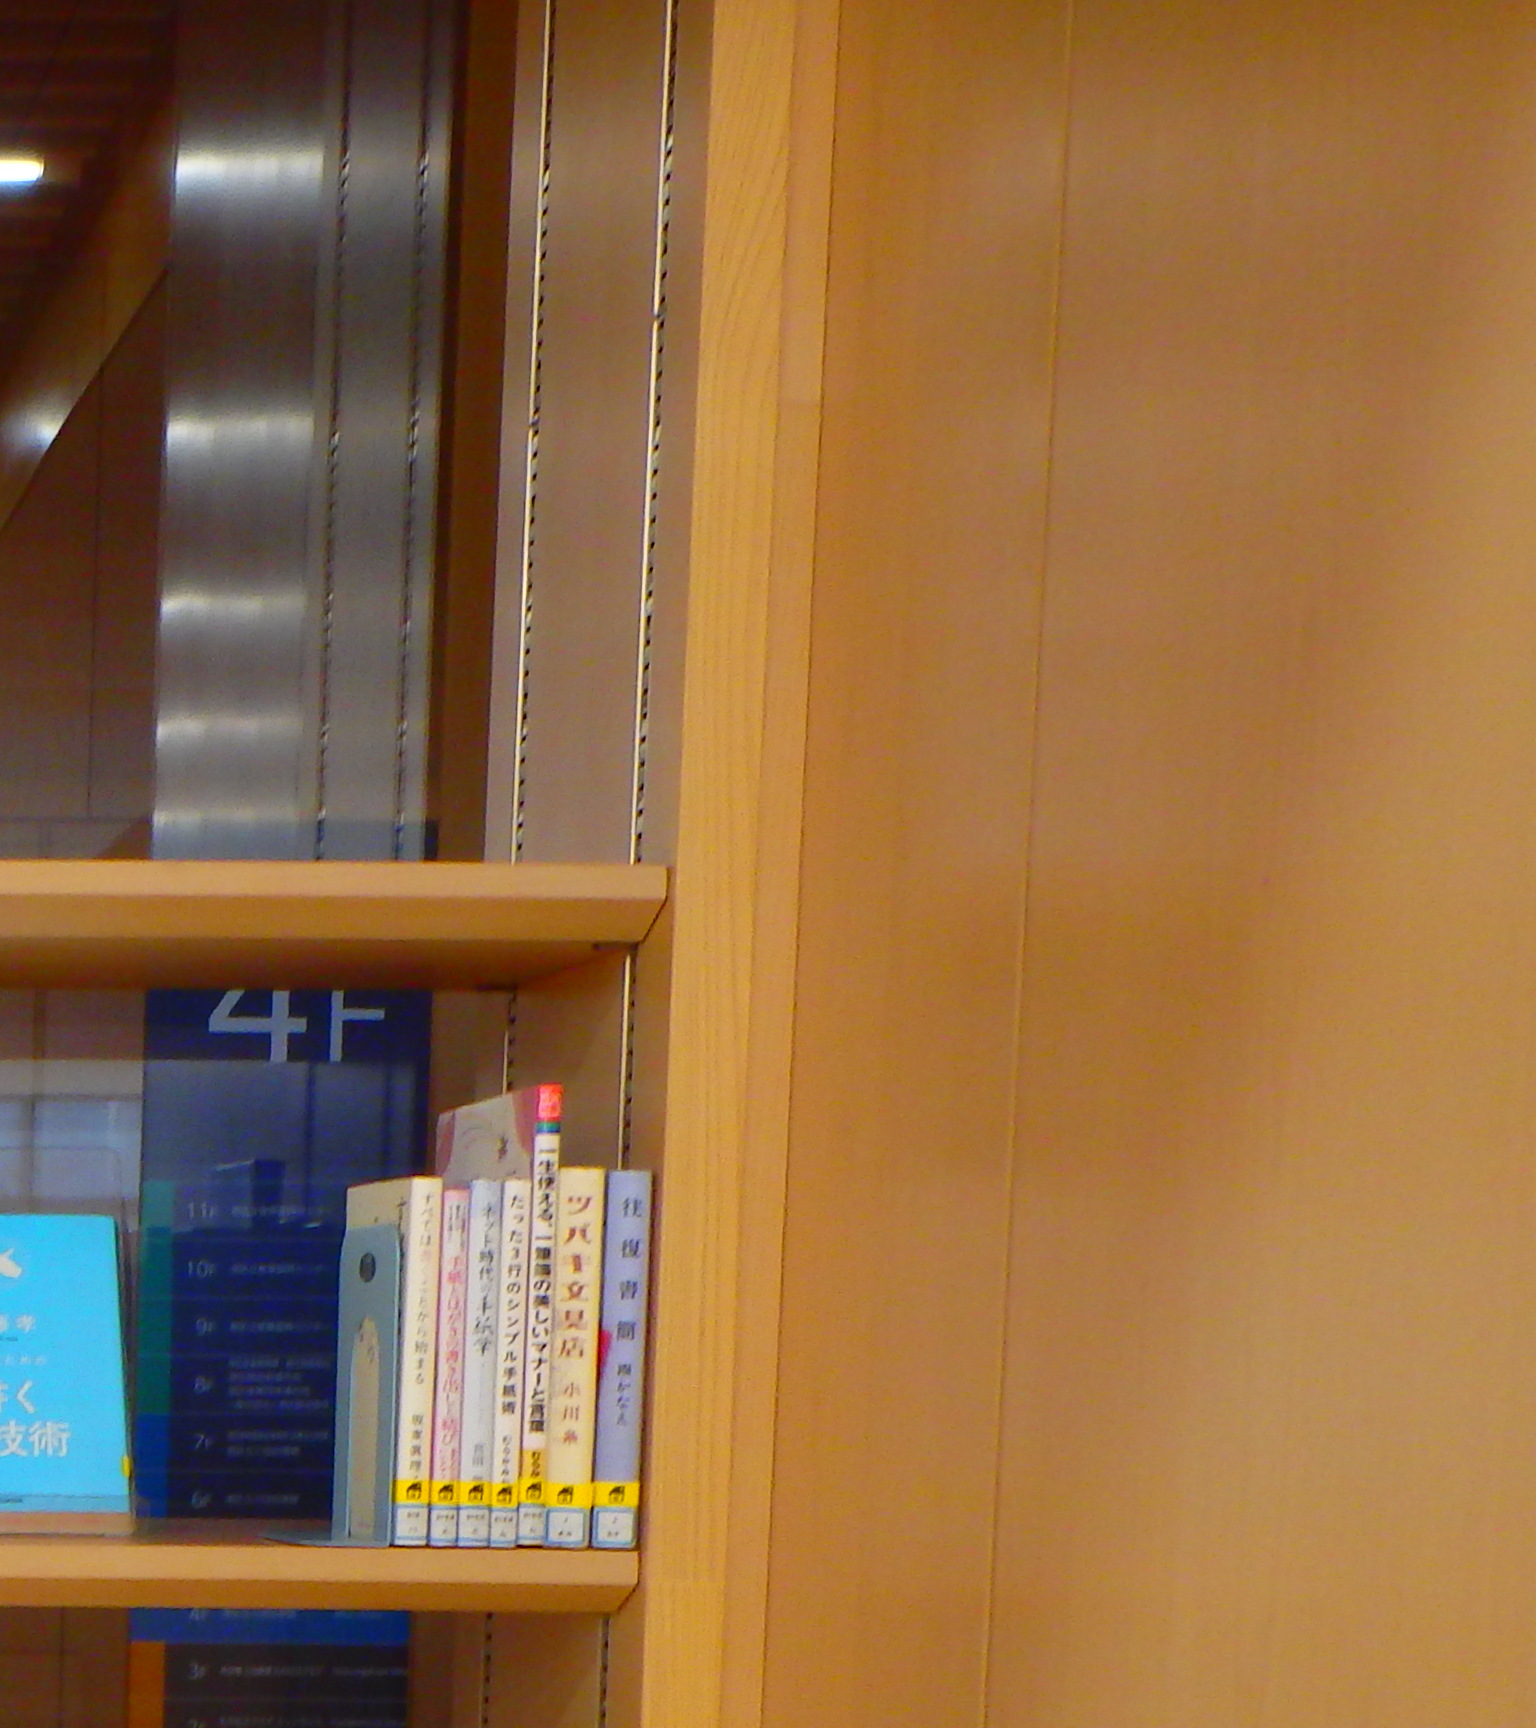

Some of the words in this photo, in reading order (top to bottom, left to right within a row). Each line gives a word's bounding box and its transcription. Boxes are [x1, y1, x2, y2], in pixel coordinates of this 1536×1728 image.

[559, 1195, 591, 1360] ツバキ文具店
